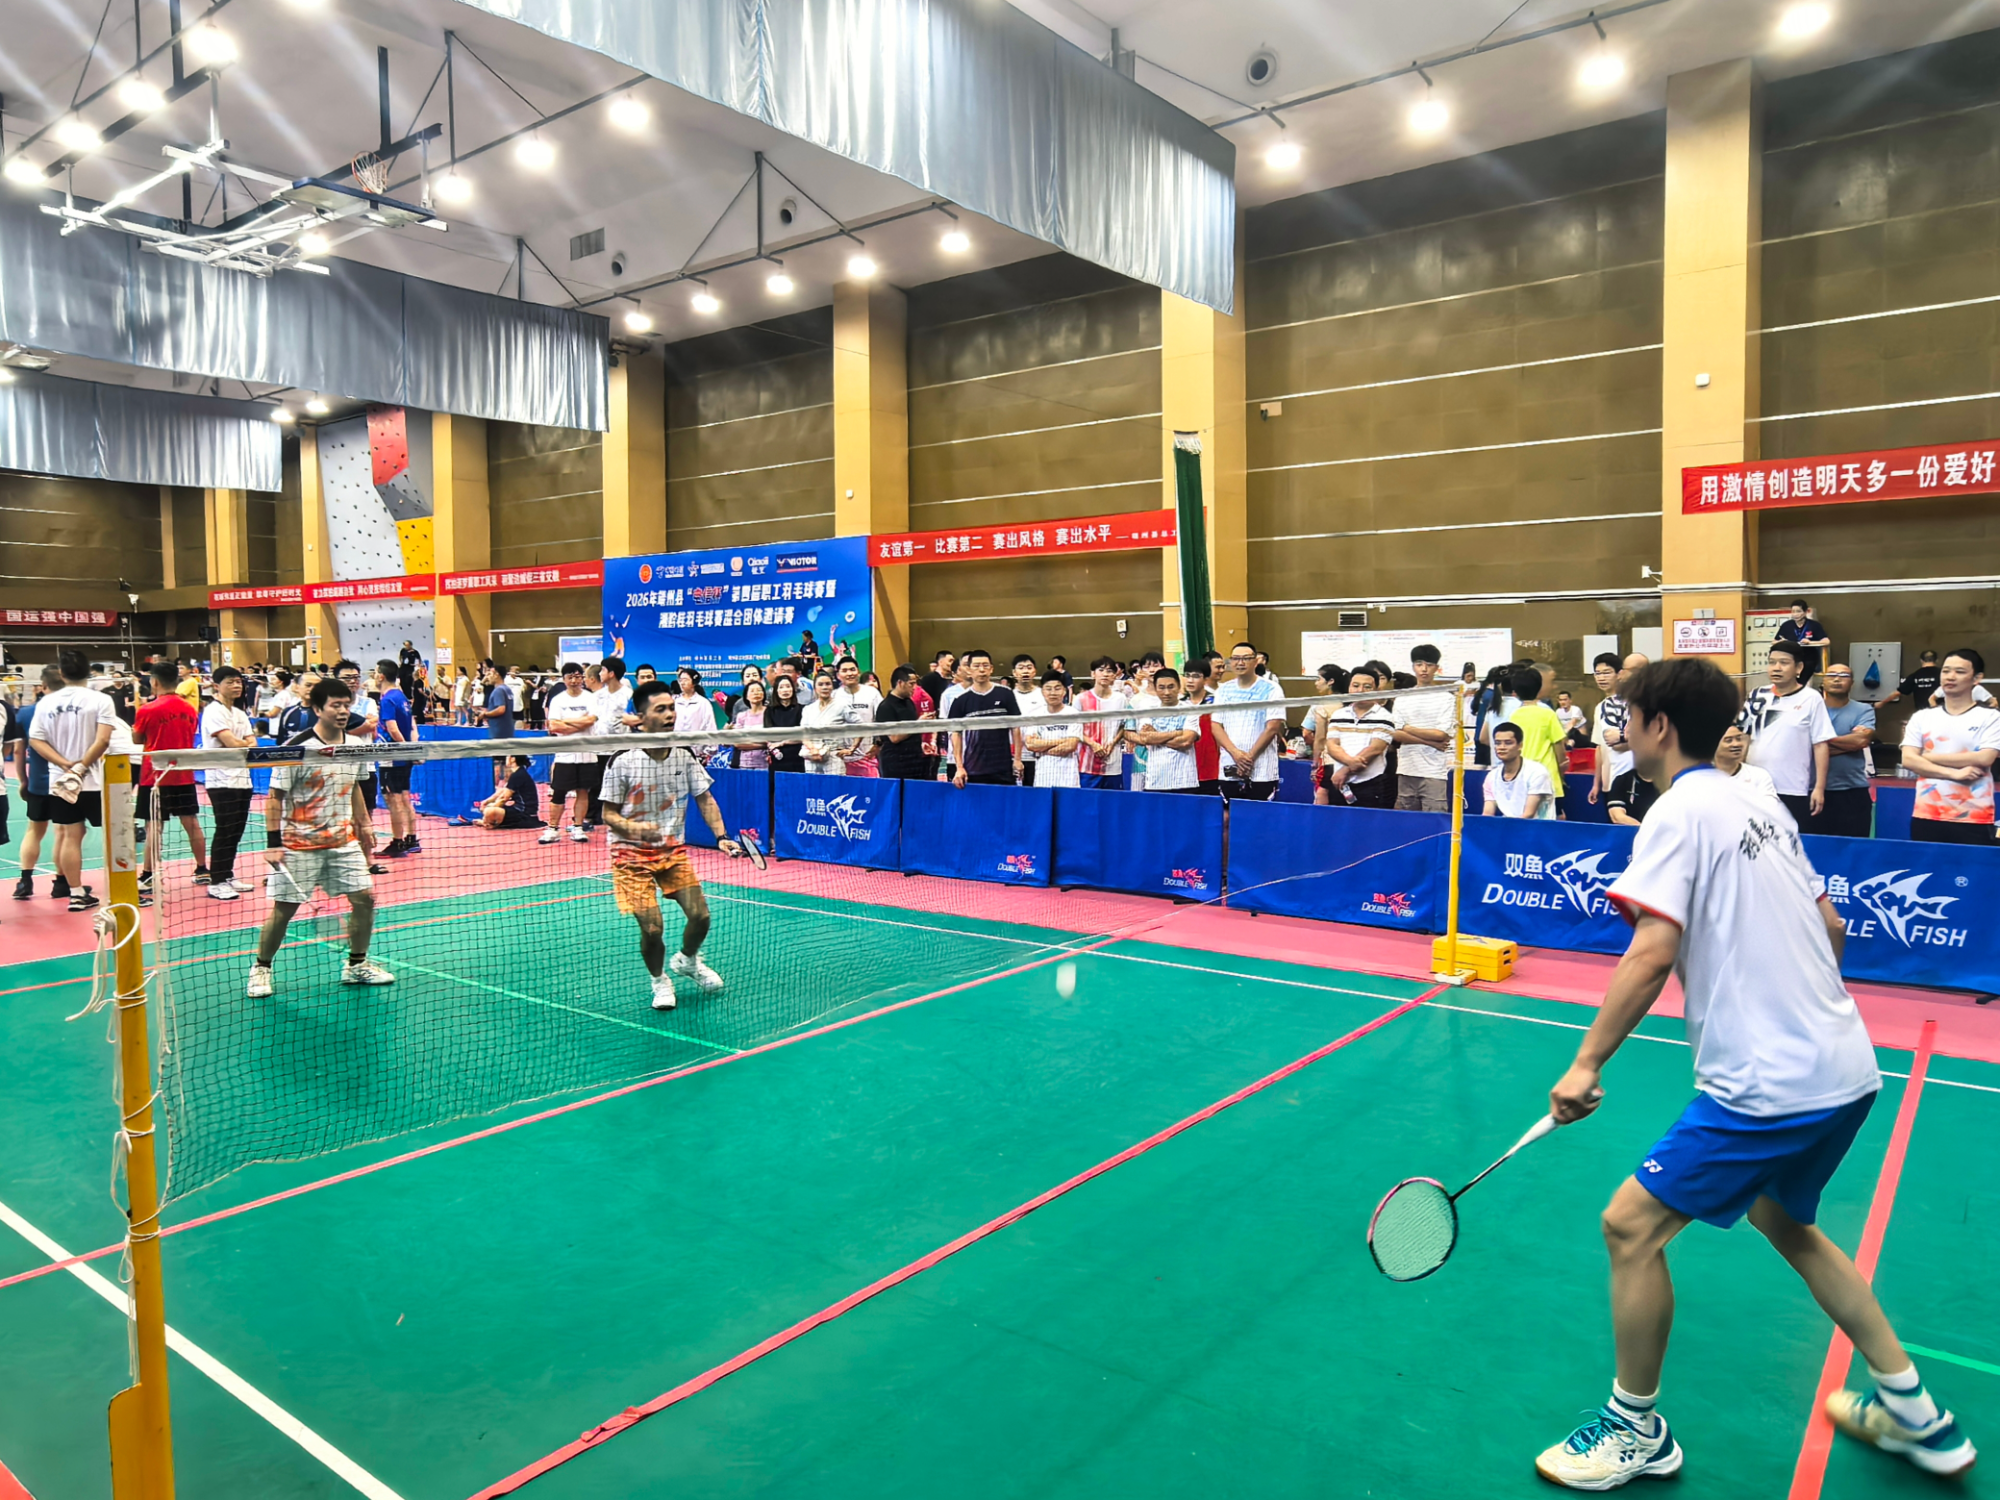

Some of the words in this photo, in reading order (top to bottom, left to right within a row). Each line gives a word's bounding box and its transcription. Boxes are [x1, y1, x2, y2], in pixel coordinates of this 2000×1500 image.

[1700, 450, 1997, 505] 用激情创造明天多一份爱好
[879, 540, 926, 559] 友谊第一
[935, 535, 984, 555] 比赛第二
[992, 528, 1046, 551] 赛出风格
[1055, 523, 1112, 546] 赛出水平
[787, 556, 818, 566] VICTOR
[806, 798, 826, 817] 双鱼
[797, 819, 837, 837] DOUBLE
[850, 827, 872, 841] FISH
[1503, 853, 1544, 880] 双鱼
[1163, 877, 1188, 887] DOUBLE
[1481, 882, 1566, 910] DOUBLE
[1361, 902, 1392, 915] DOUBLE
[1399, 909, 1416, 918] FISH
[1909, 925, 1968, 948] FISH
